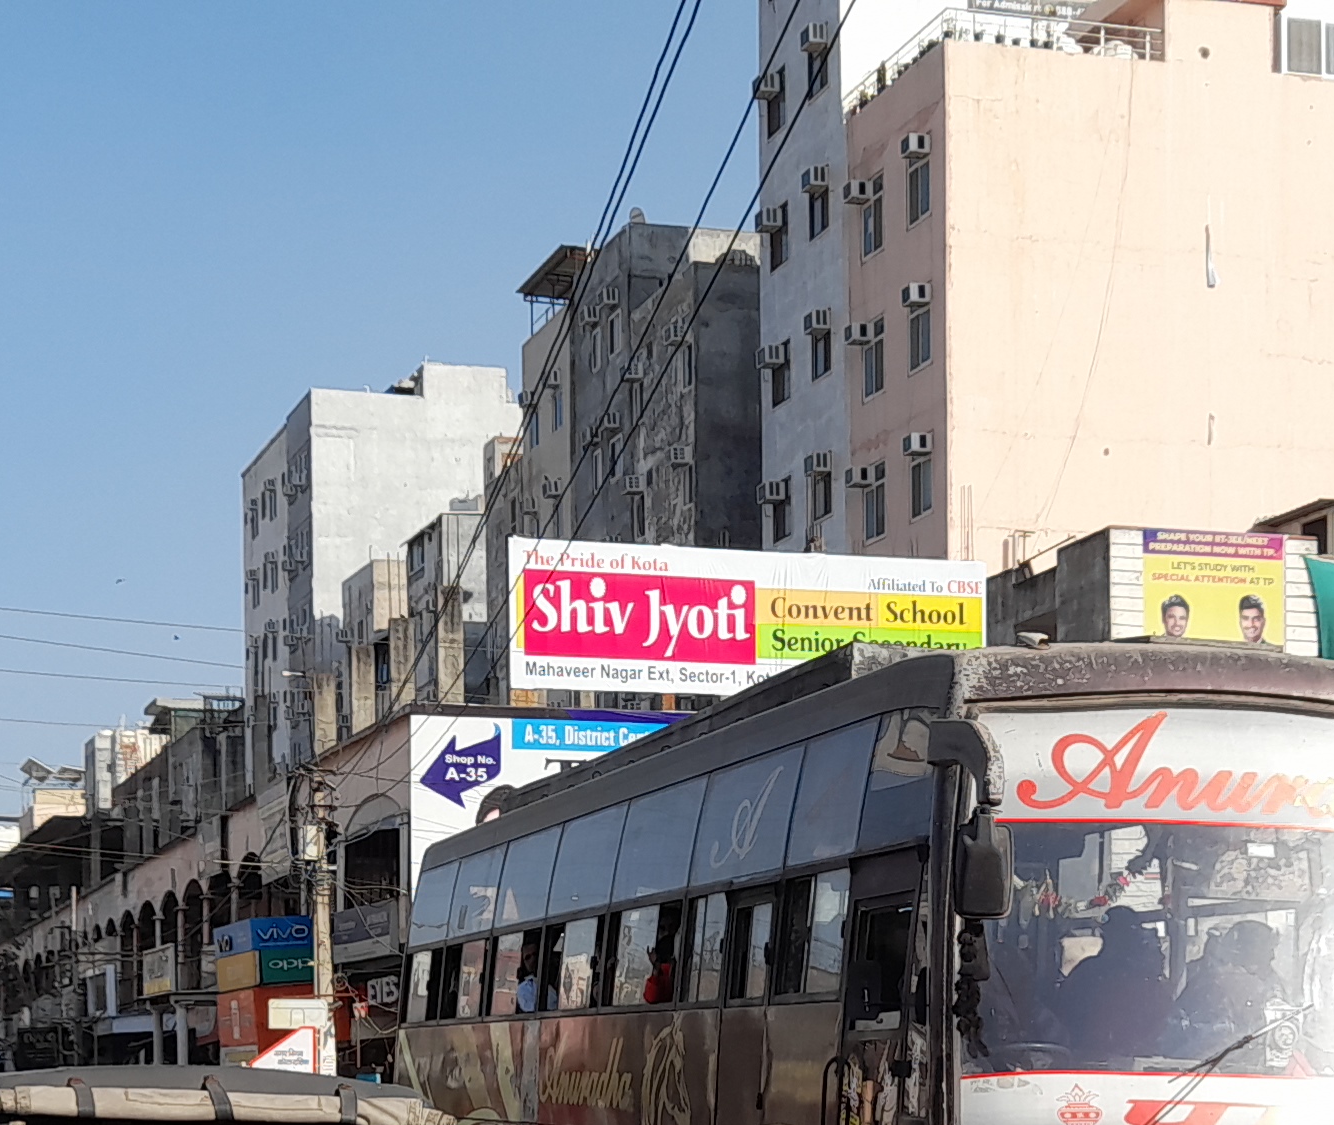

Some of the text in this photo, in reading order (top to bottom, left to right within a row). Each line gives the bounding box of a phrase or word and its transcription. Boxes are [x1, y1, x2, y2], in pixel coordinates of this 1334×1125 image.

[523, 550, 669, 572] The Pride of Kota
[1171, 561, 1255, 573] LET'S STUDY WITH
[868, 577, 983, 595] Affiliated To CBSE
[1152, 572, 1275, 586] SPECIAL ATTENTION AT TP
[531, 577, 751, 657] Shiv Jyoti
[770, 596, 967, 626] Convent School
[771, 628, 846, 653] Senior
[525, 661, 743, 687] Mahaveer Nagar Ext, Sector-1,
[524, 724, 616, 747] A-35, District
[444, 754, 497, 766] Shop No.
[445, 766, 488, 782] A-35
[257, 923, 309, 940] vivo
